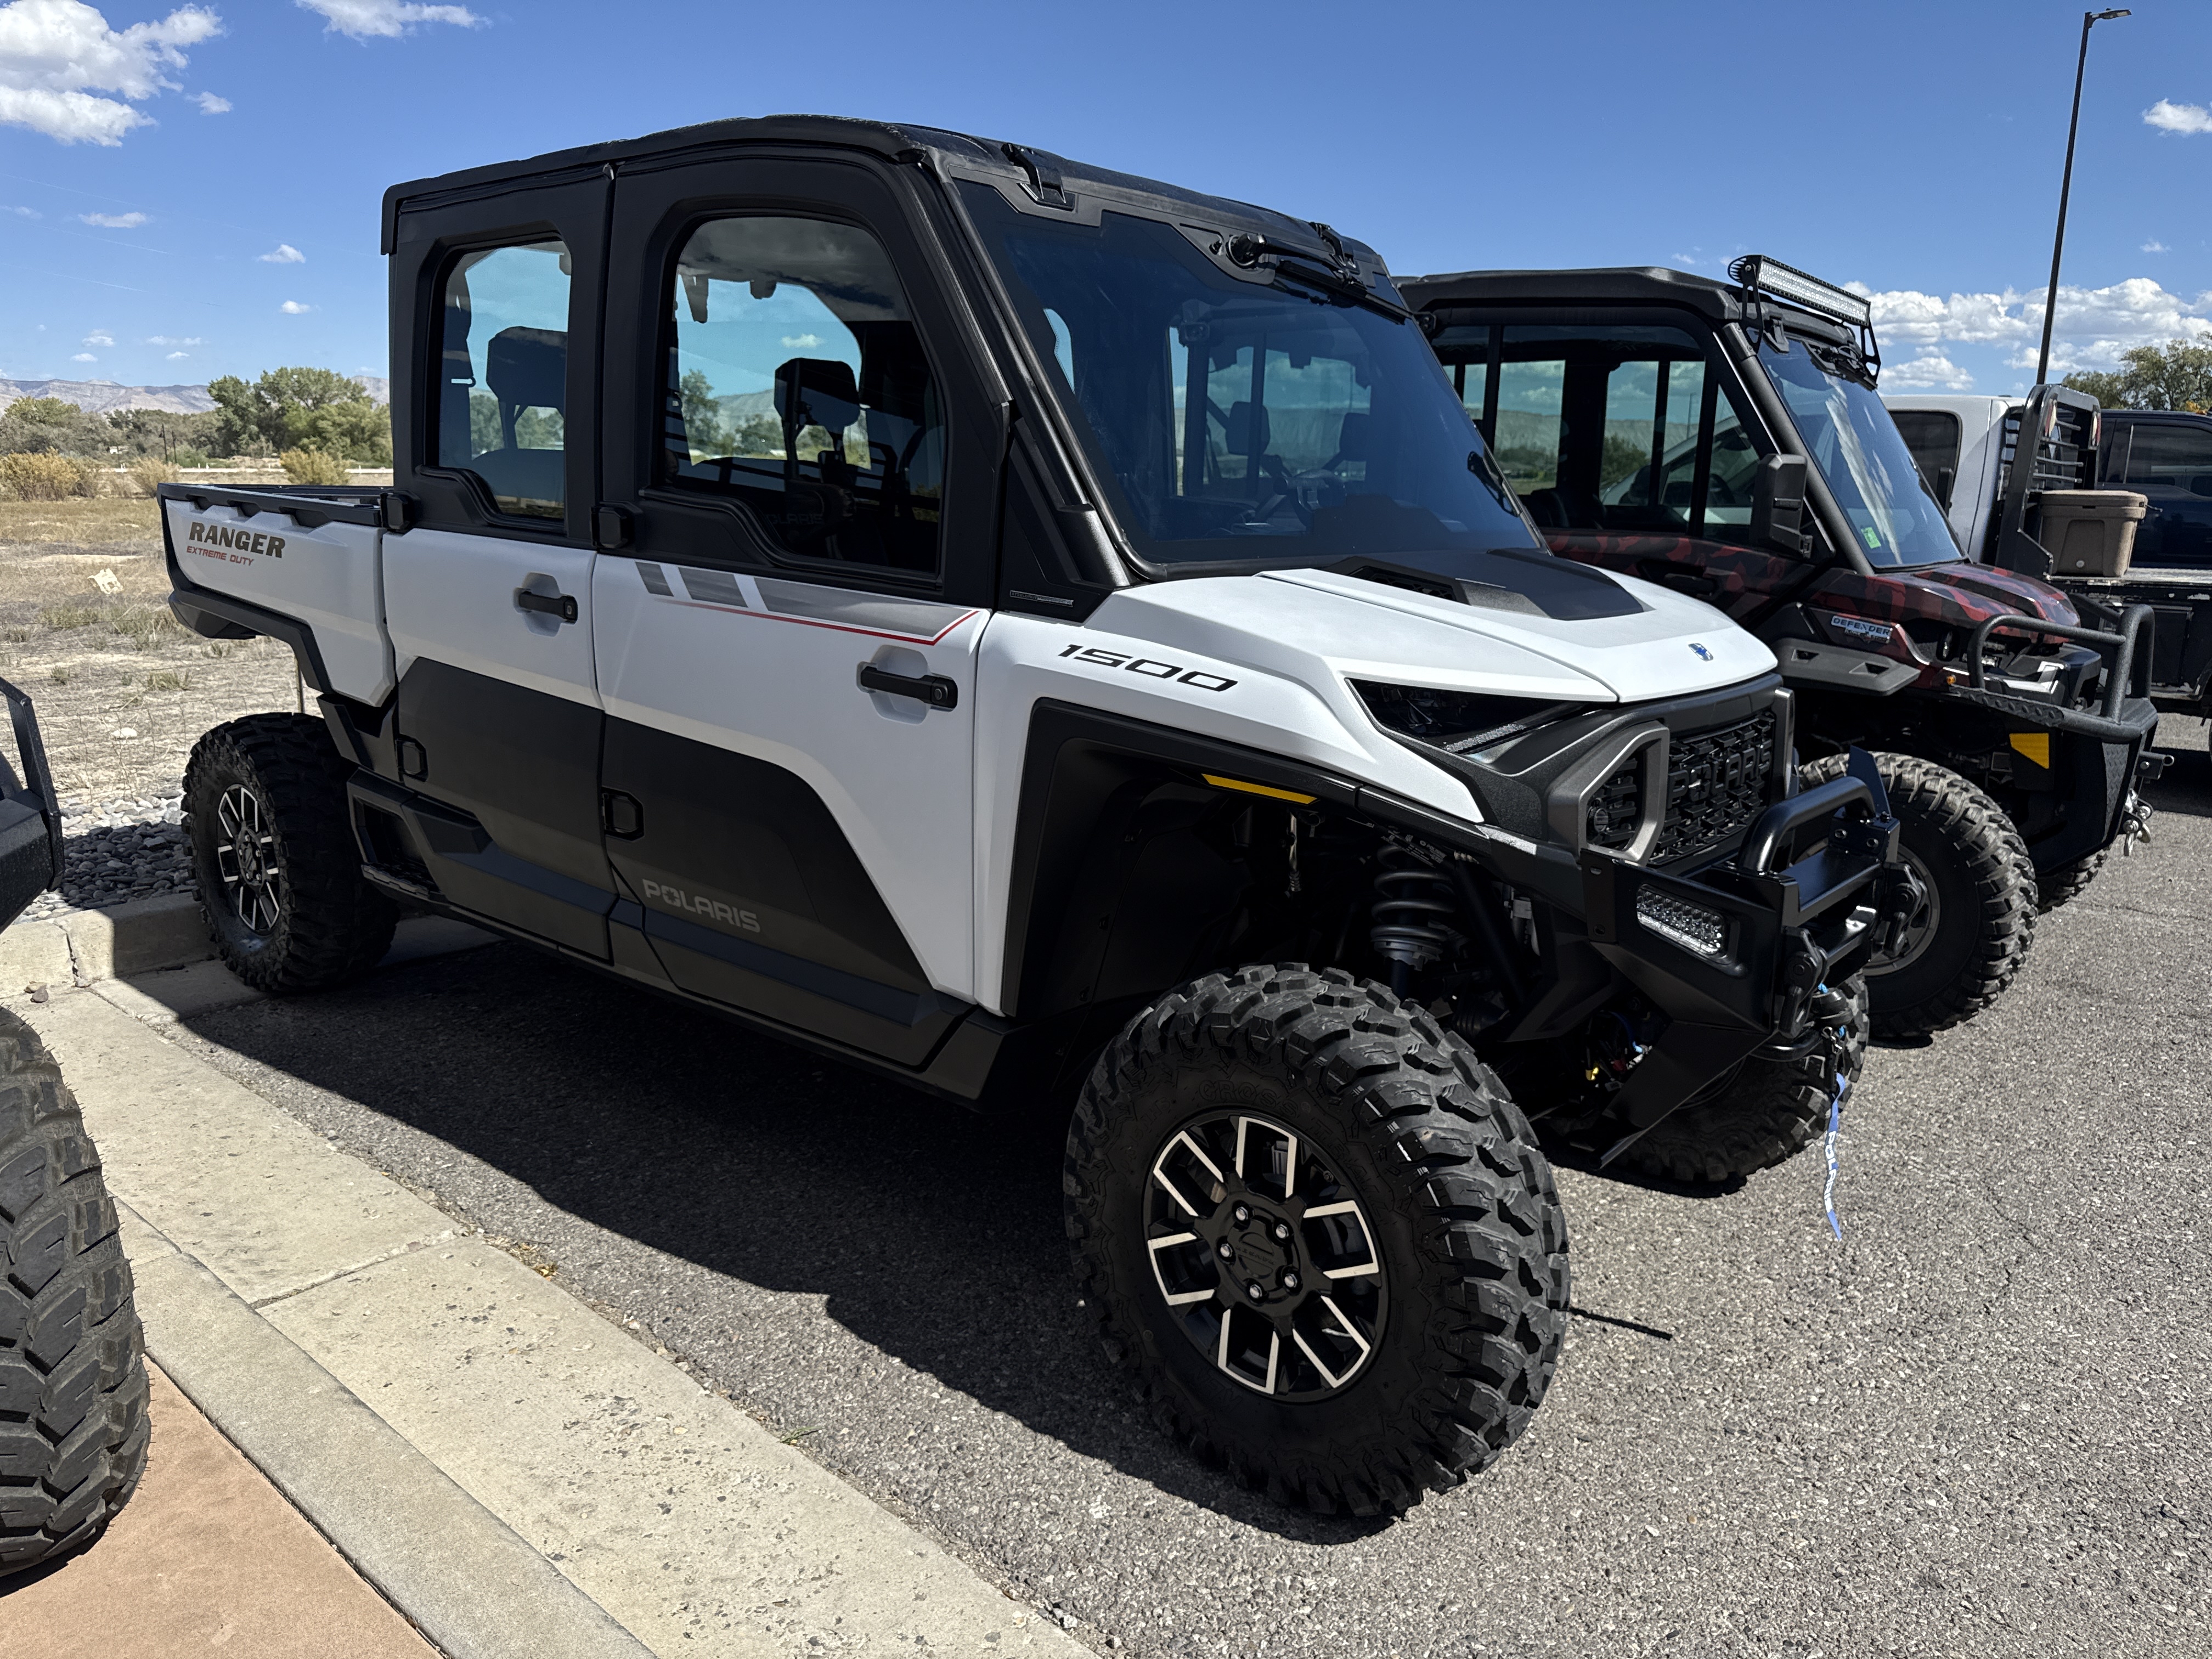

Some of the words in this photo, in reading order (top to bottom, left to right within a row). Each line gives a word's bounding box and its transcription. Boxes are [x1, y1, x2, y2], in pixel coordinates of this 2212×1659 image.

[186, 545, 228, 561] EXTREME
[229, 554, 255, 566] DUTY
[189, 521, 286, 558] RANGER
[1833, 617, 1889, 636] DEFENDER
[1058, 644, 1238, 692] 1500
[642, 878, 761, 933] POLARIS
[1199, 1079, 1299, 1119] CROSS
[1824, 1130, 1838, 1214] POLARIS
